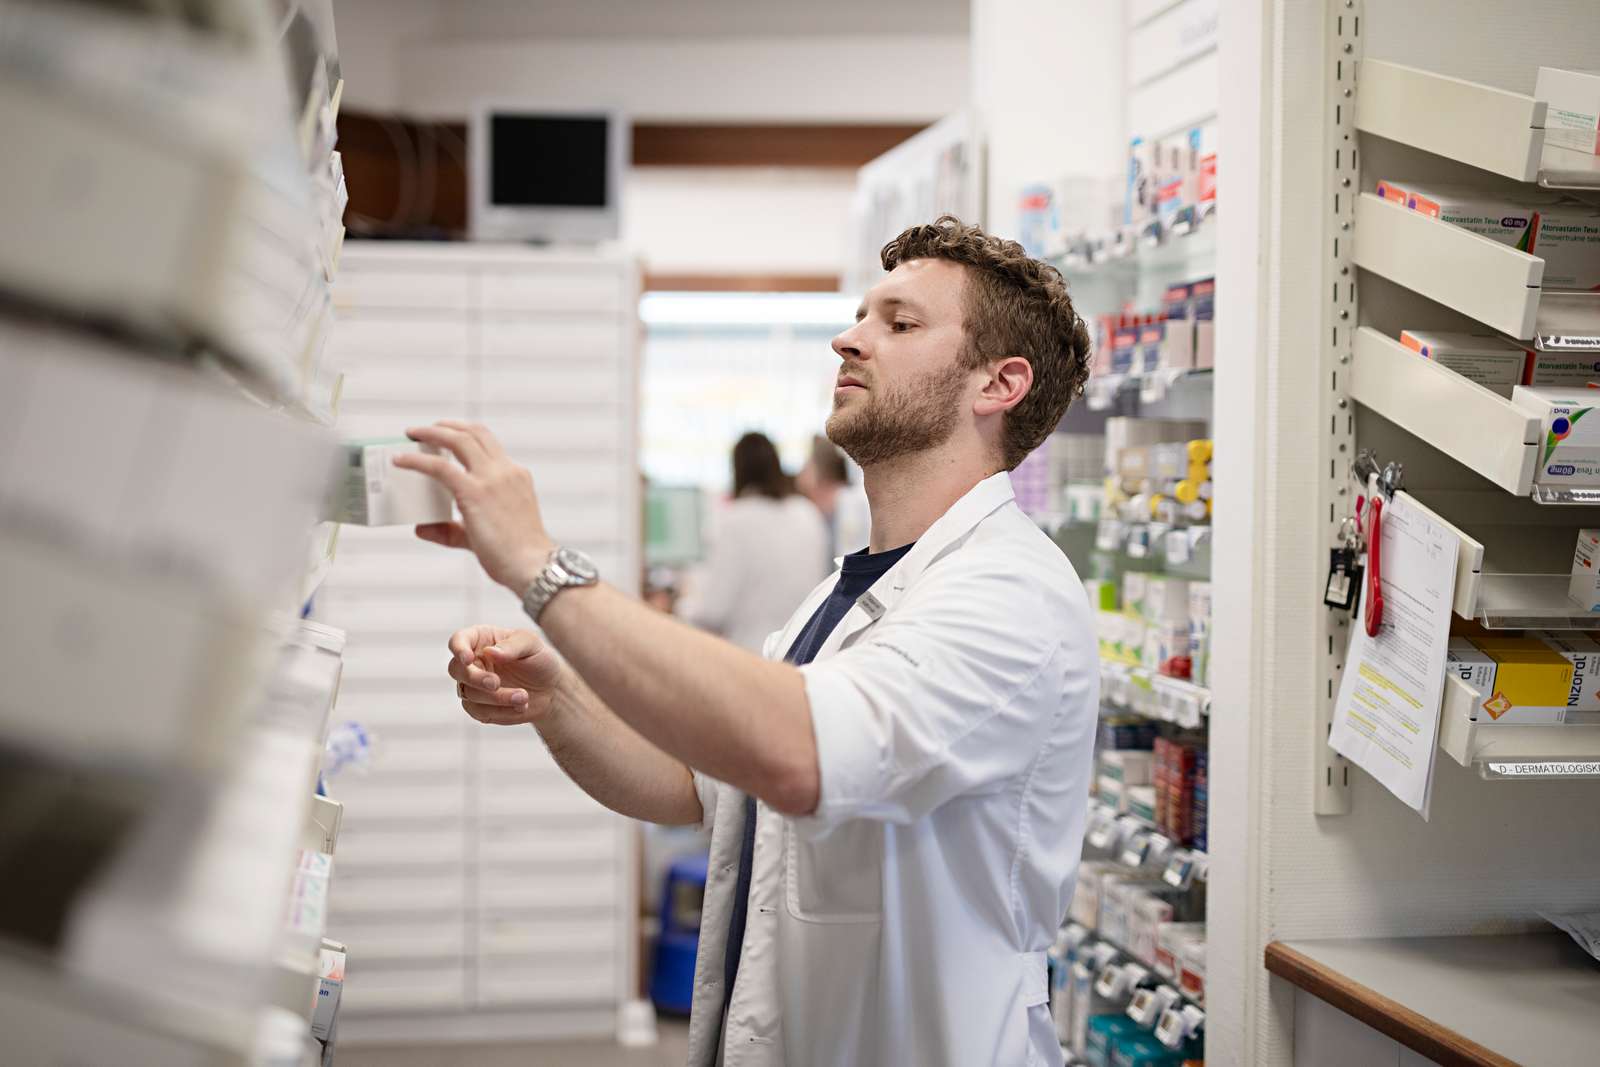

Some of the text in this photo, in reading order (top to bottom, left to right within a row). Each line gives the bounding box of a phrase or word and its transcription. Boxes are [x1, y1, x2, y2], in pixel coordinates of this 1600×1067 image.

[1485, 217, 1500, 225] Teva
[1541, 223, 1599, 233] Atorvastatin Teva
[1567, 655, 1587, 706] Nizoral
